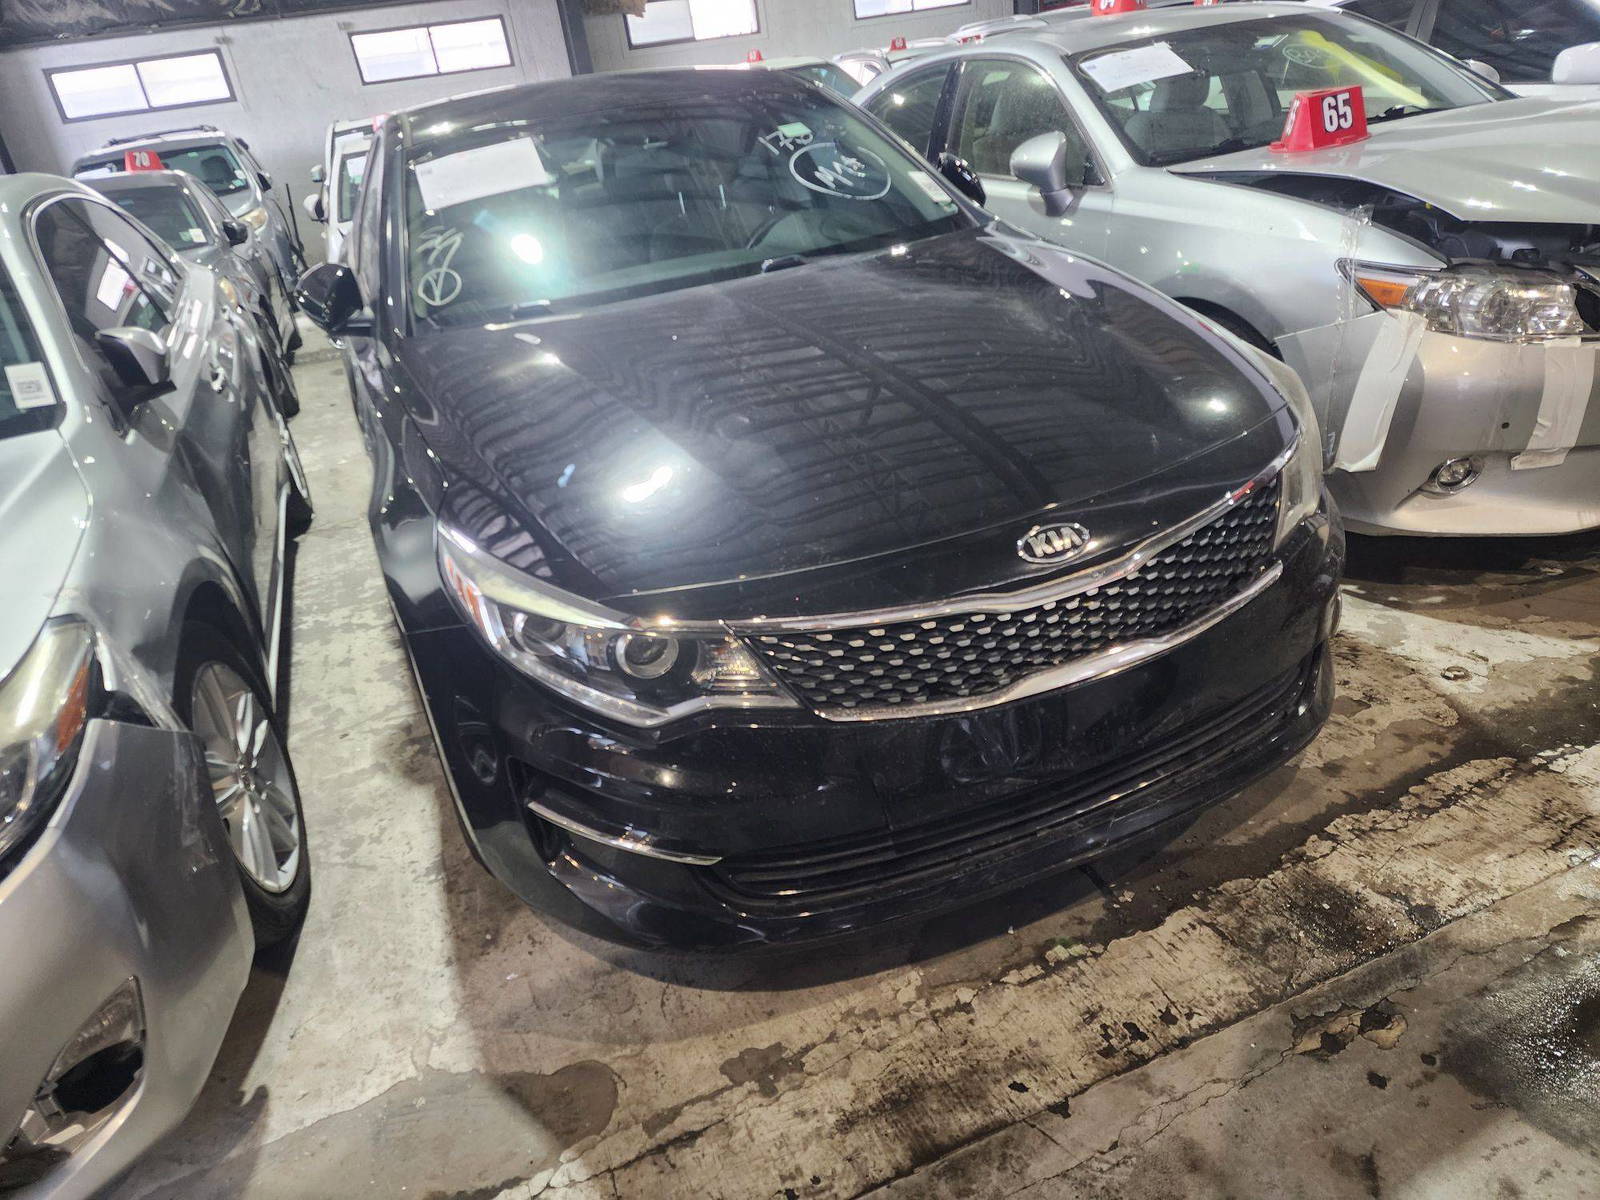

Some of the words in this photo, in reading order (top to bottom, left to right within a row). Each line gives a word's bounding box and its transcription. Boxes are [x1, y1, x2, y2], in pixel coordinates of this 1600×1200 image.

[1322, 92, 1354, 133] 65
[133, 151, 152, 168] 70
[1027, 526, 1083, 558] KIA
